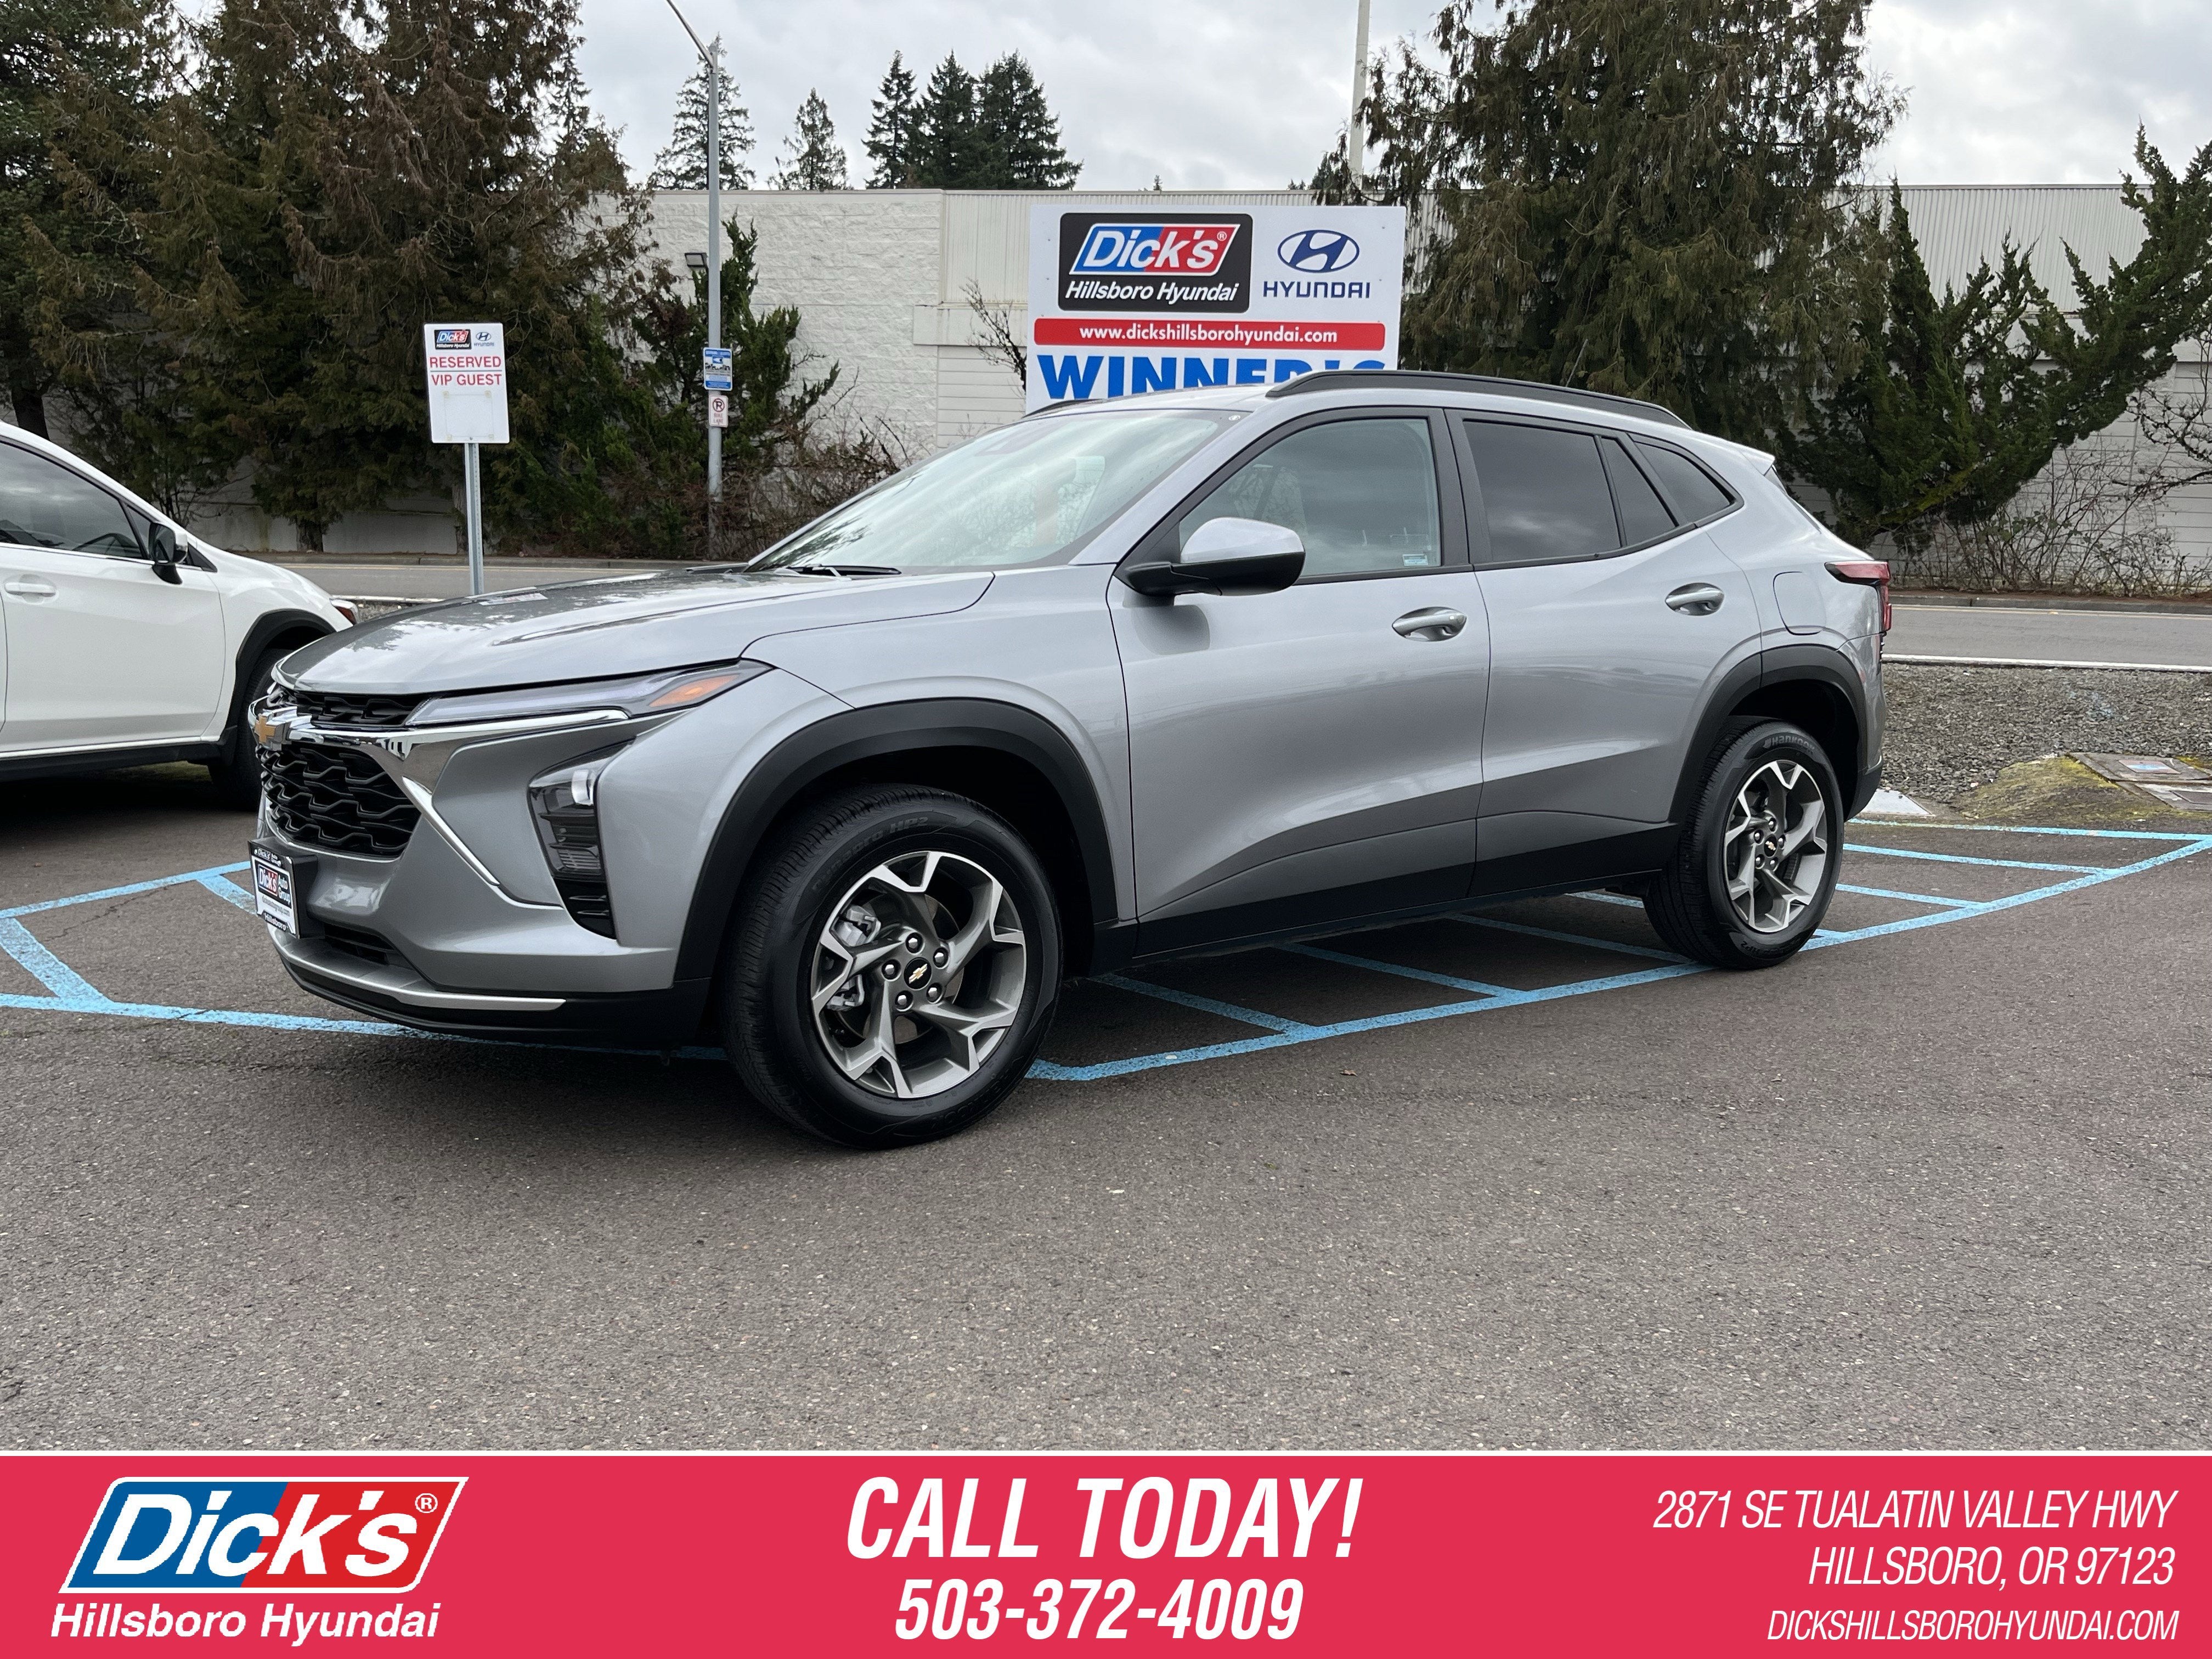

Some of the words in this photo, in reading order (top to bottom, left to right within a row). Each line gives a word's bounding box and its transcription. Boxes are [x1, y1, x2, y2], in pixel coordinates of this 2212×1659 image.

[1065, 281, 1154, 301] Hillsboro
[1156, 282, 1239, 305] Hyundai
[1263, 281, 1370, 298] HYUNDAI
[1079, 323, 1338, 346] www.dickshillsborohyundai.com
[430, 356, 501, 368] RESERVED
[431, 374, 453, 386] VIP
[456, 374, 502, 385] GUEST
[259, 867, 276, 893] Dick's
